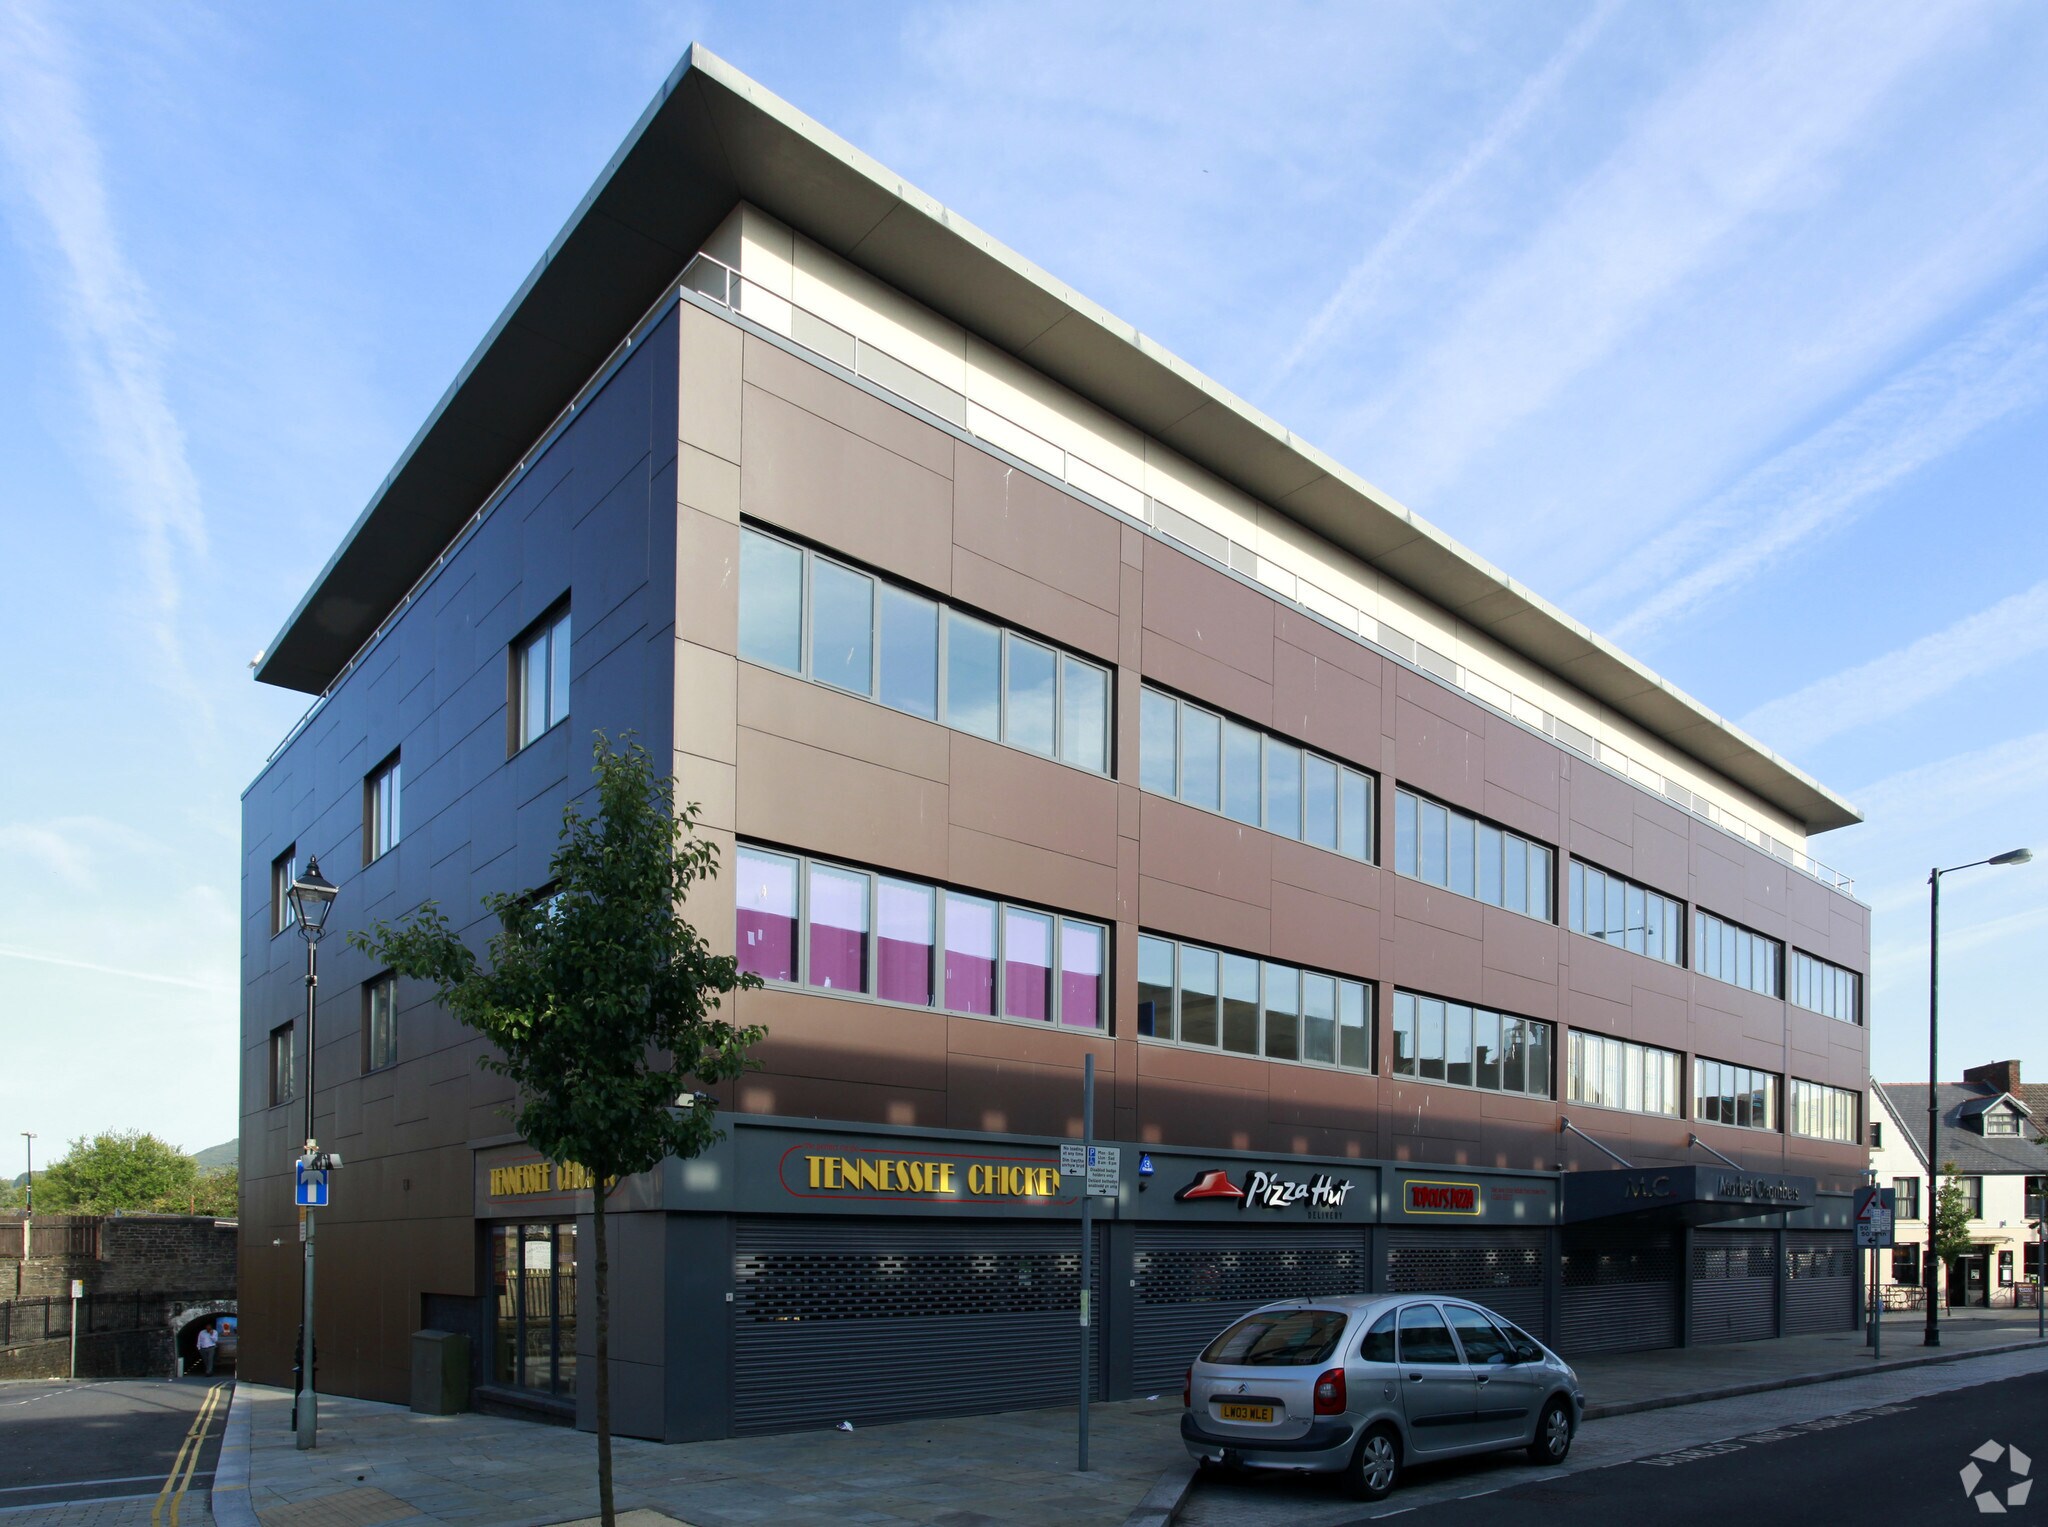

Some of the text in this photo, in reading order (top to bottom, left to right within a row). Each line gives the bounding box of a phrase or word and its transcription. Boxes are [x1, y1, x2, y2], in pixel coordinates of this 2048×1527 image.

[489, 1162, 552, 1196] TENNESSEE
[804, 1155, 956, 1193] TENNESSEE
[1246, 1171, 1355, 1209] Pizza Hut
[1307, 1211, 1343, 1220] DELIVERY
